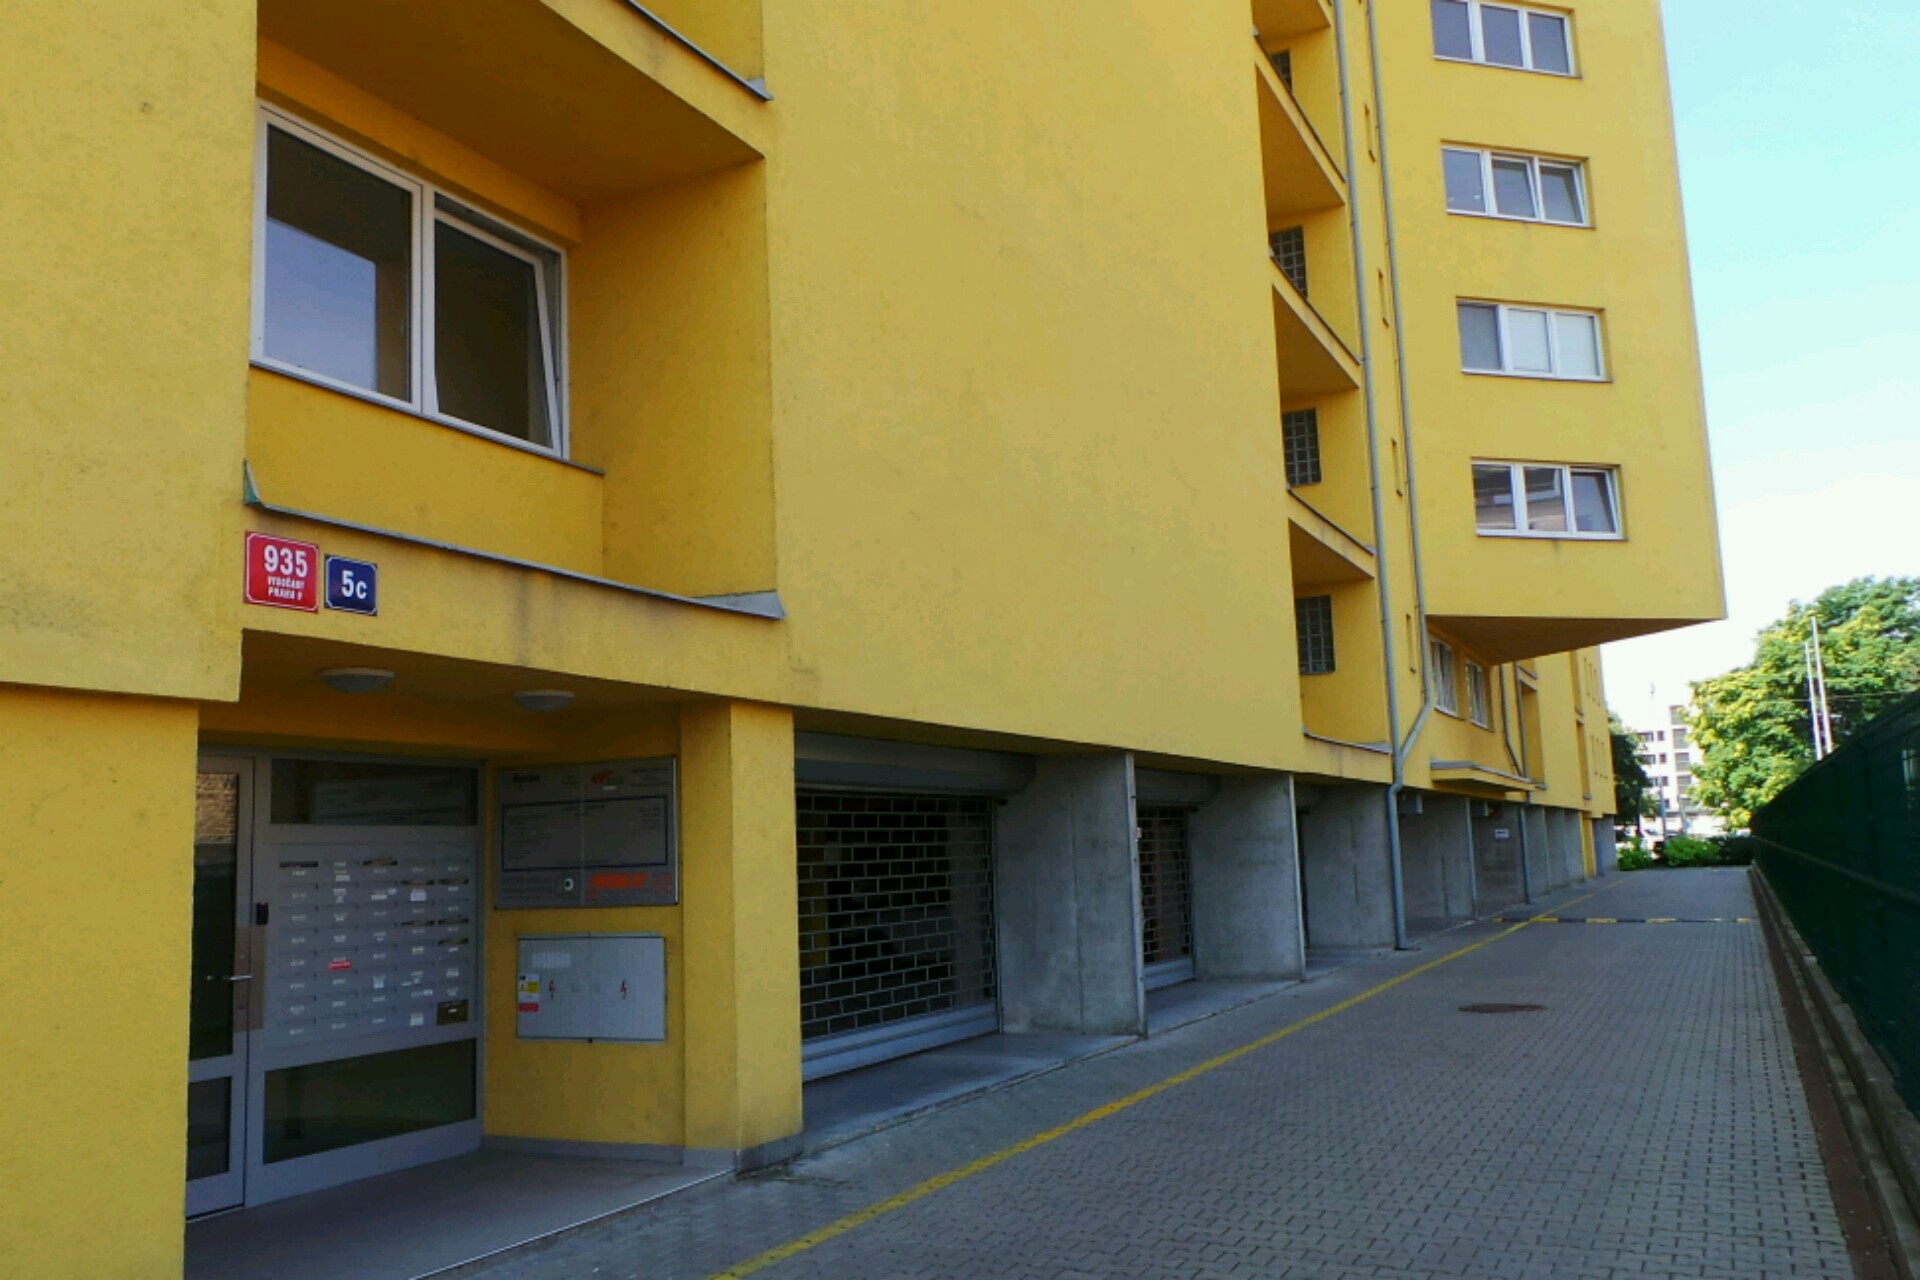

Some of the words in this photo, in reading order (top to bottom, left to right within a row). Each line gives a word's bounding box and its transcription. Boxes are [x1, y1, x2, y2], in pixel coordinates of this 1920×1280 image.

[264, 544, 308, 577] 935
[268, 587, 295, 599] PRAHA
[341, 570, 367, 599] 5c
